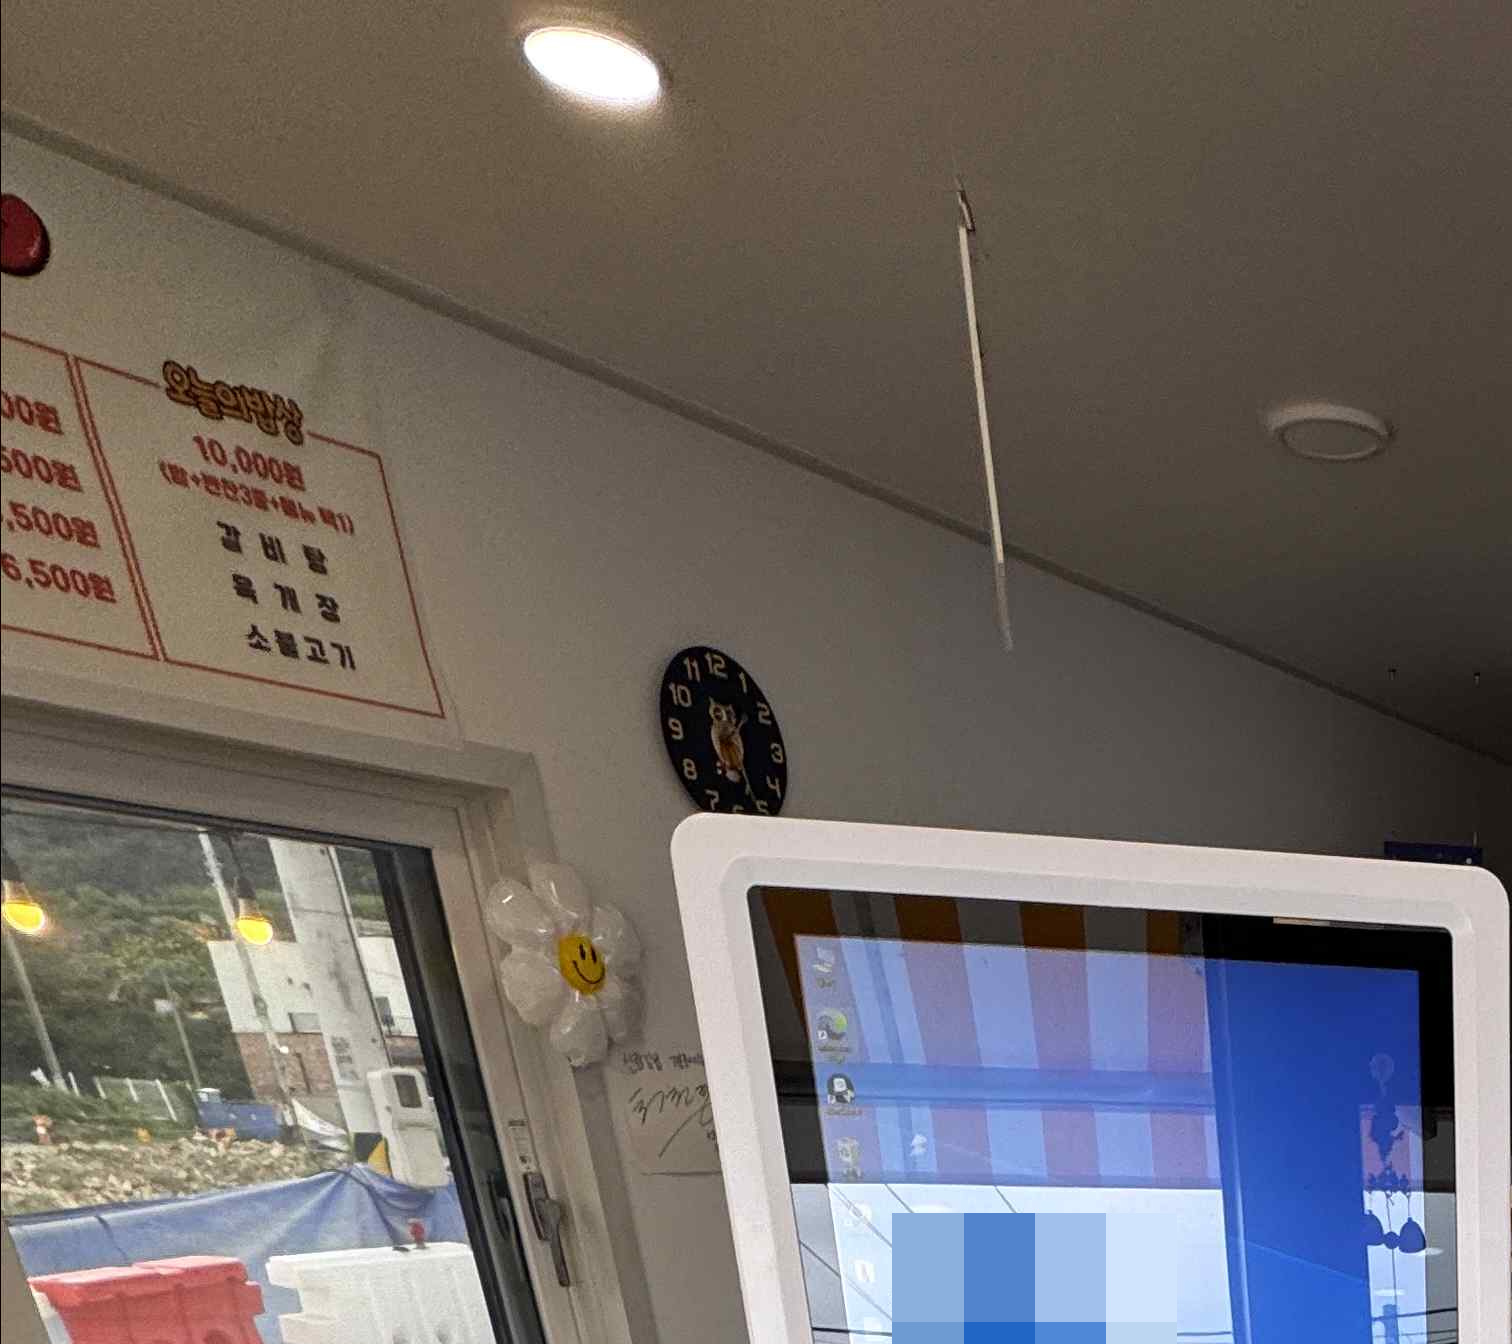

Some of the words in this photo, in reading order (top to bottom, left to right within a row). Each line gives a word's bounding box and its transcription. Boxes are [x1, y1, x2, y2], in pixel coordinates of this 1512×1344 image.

[193, 435, 305, 491] 10,000원
[1, 553, 116, 603] 6,500원
[247, 624, 356, 670] 소불고기
[684, 656, 700, 682] 11
[705, 653, 728, 679] 12
[668, 682, 692, 707] 10
[739, 672, 747, 693] 1
[756, 703, 772, 725] 2
[668, 718, 684, 740] 9
[770, 743, 784, 764] 3
[682, 758, 698, 781] 8
[766, 775, 781, 799] 4
[705, 789, 719, 811] 7
